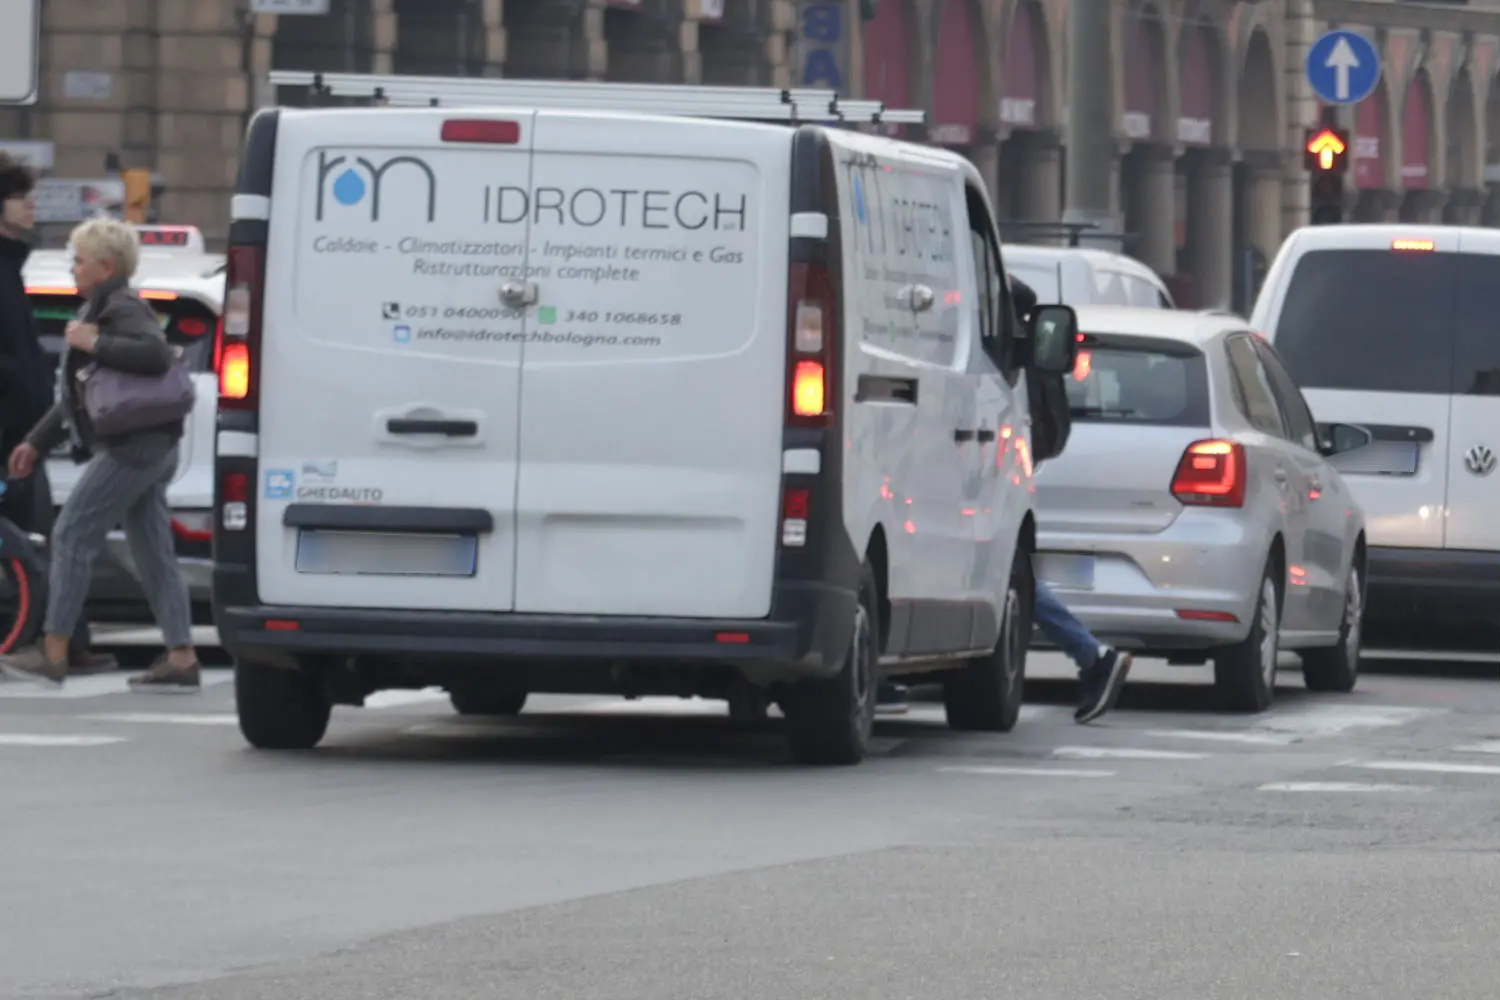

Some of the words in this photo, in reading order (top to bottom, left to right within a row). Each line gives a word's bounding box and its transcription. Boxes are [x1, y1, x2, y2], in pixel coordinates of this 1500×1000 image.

[482, 185, 746, 232] IDROTECH
[313, 236, 379, 254] Caldaie
[398, 236, 524, 256] Climatizzatori
[543, 240, 619, 262] Impianti
[624, 245, 687, 261] termici
[692, 250, 704, 262] e
[709, 247, 744, 264] Gas
[413, 257, 552, 278] Ristrutturazioni
[556, 263, 640, 283] complete
